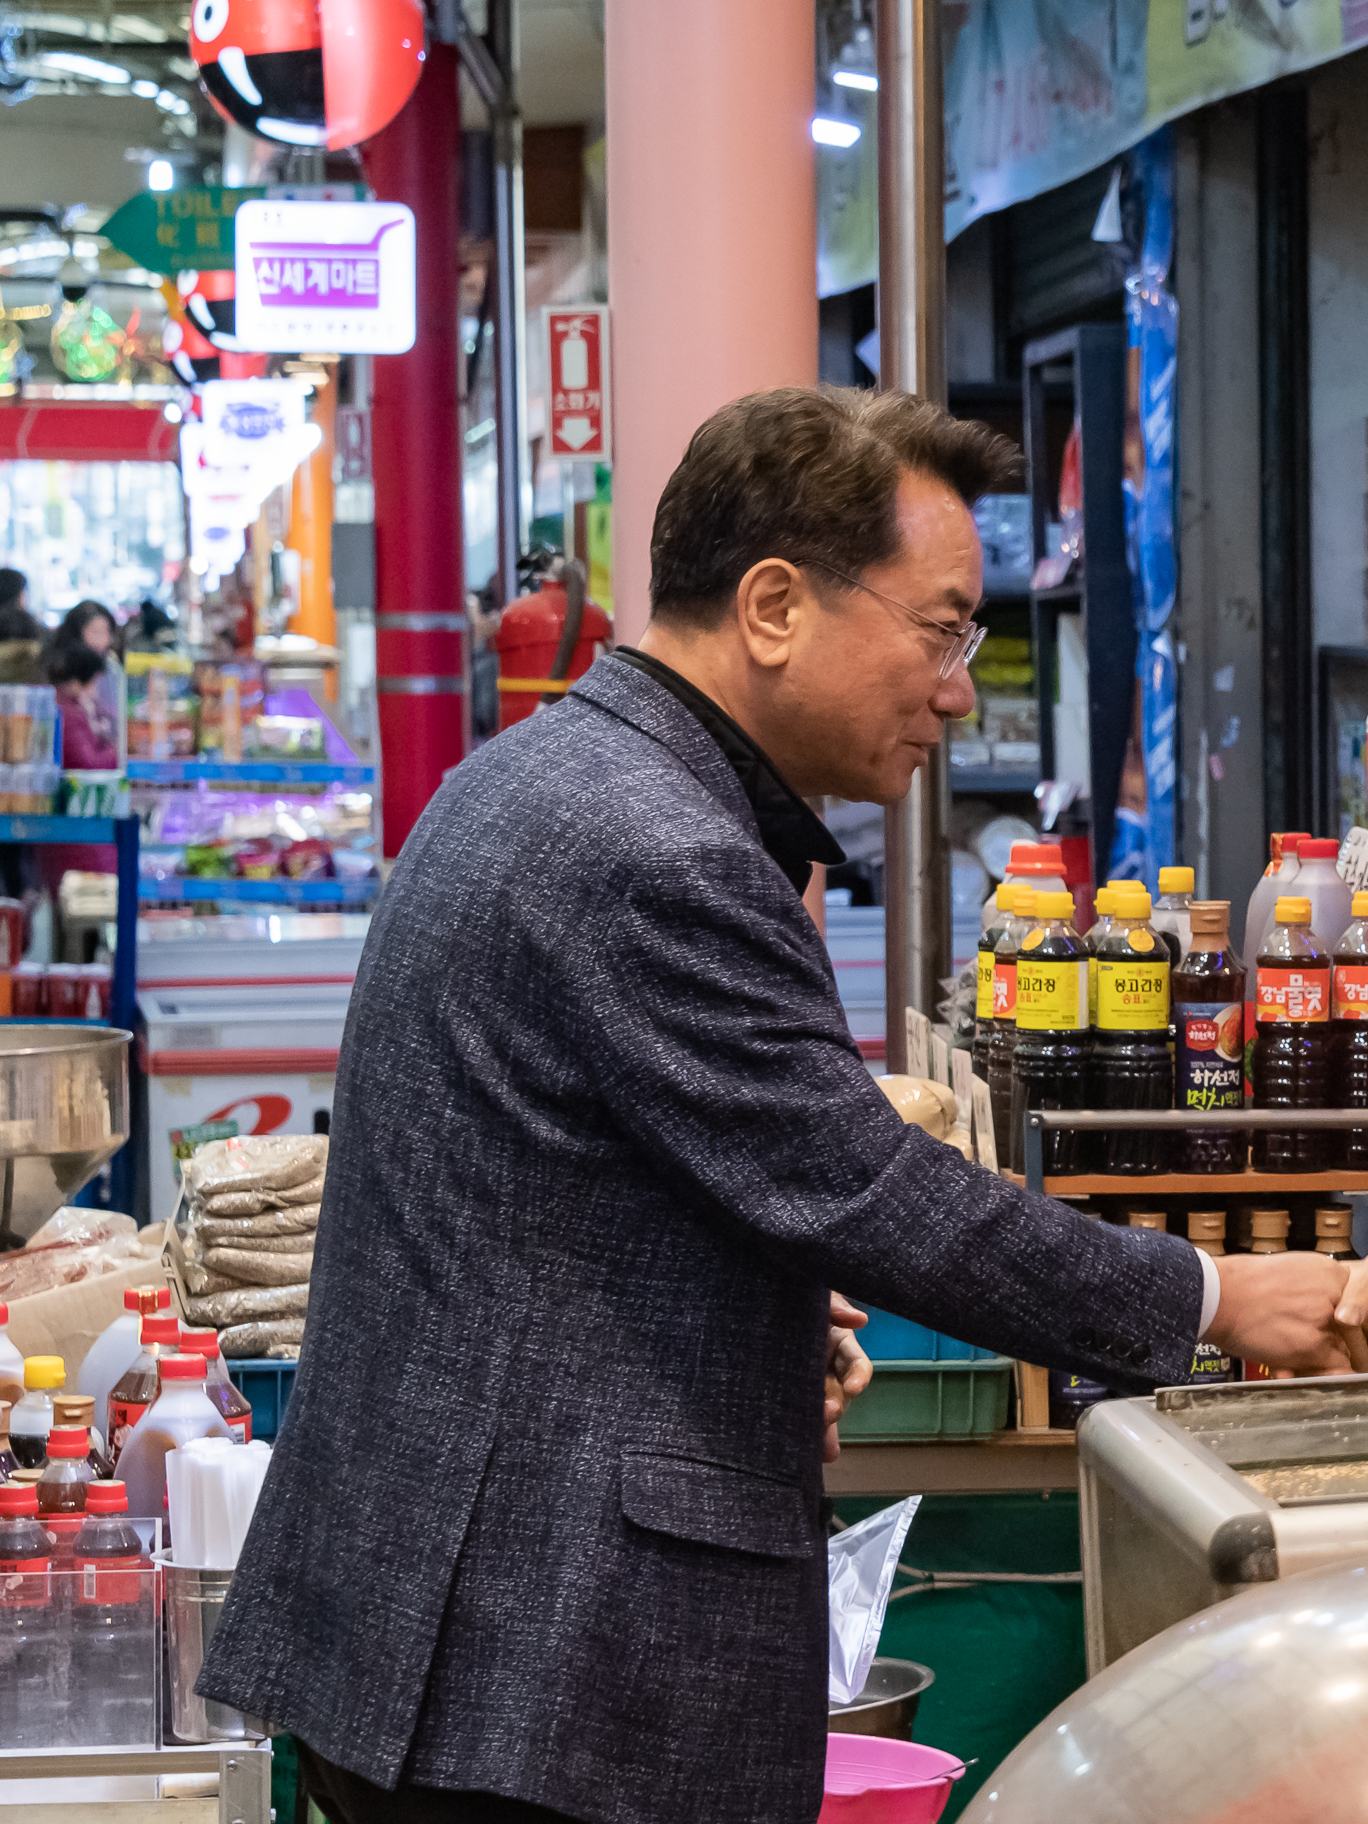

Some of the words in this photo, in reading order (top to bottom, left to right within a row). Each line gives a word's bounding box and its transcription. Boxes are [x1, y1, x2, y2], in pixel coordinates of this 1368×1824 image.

[257, 261, 377, 296] 신세계마트
[554, 391, 600, 411] 소화기
[1115, 978, 1163, 994] 몽고간장
[1261, 974, 1322, 1011] 강남물엿
